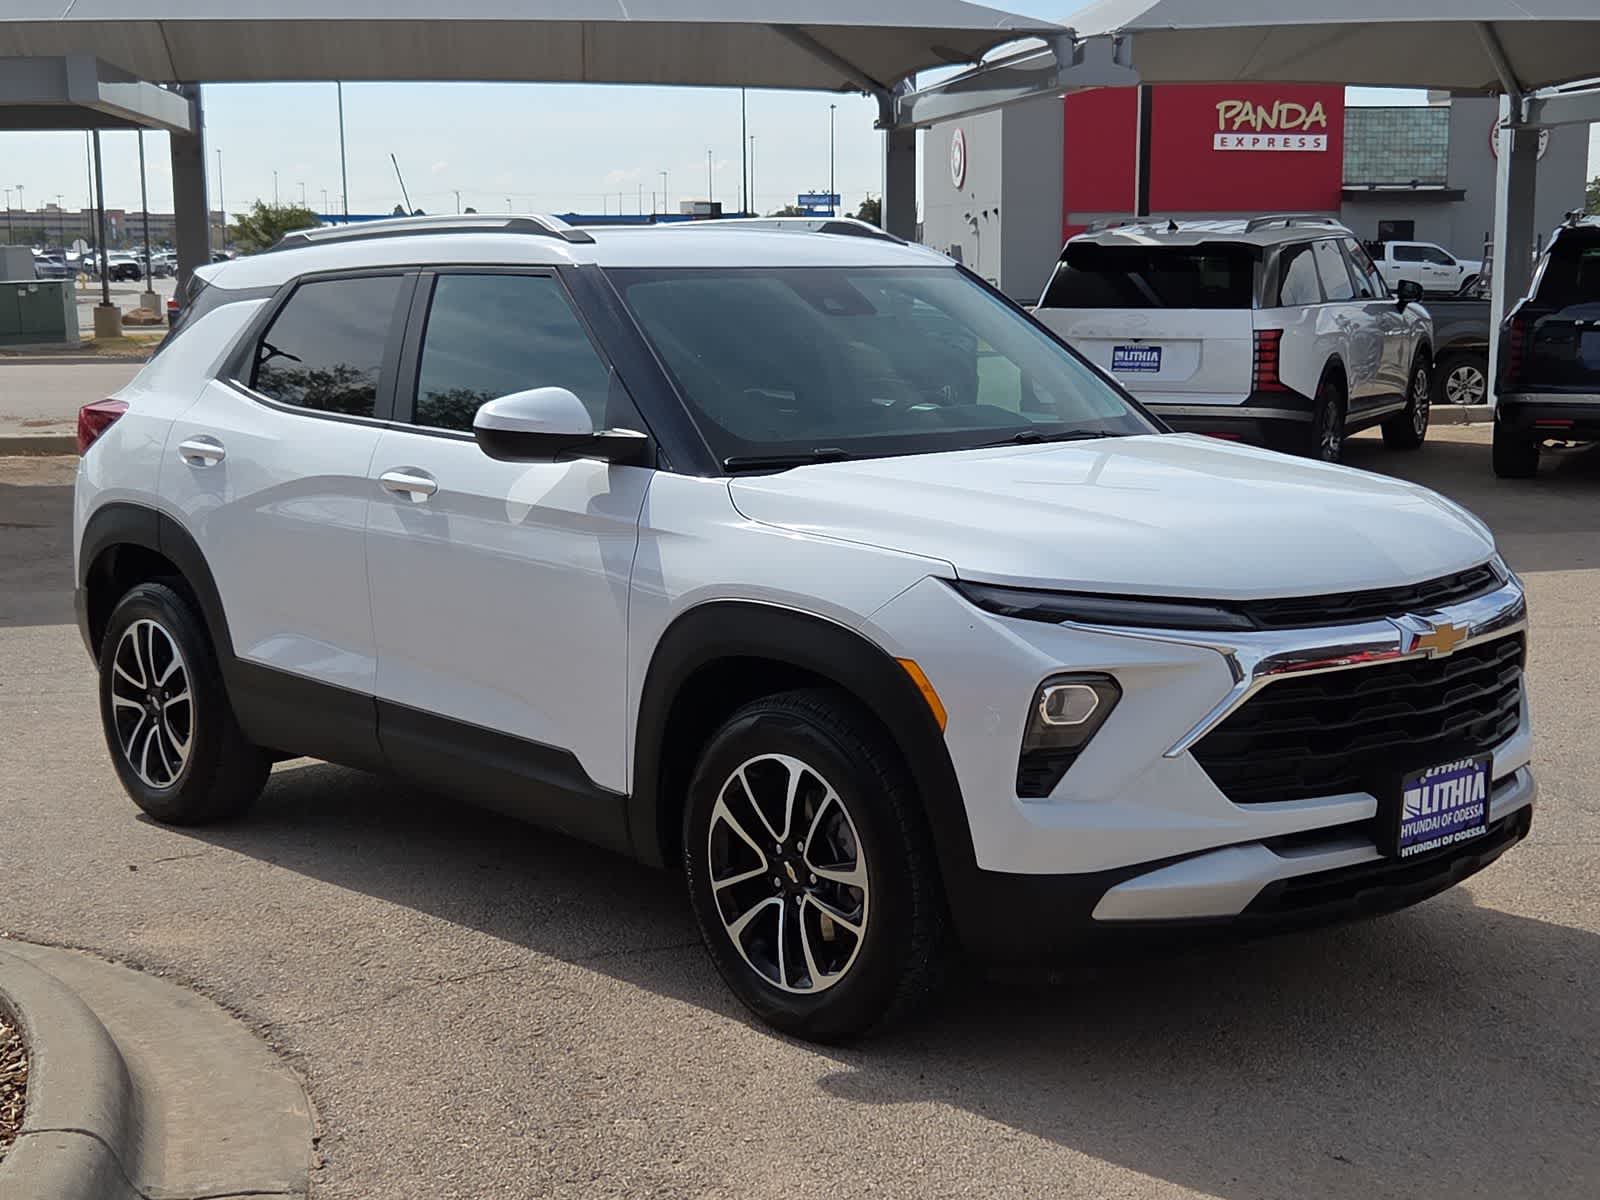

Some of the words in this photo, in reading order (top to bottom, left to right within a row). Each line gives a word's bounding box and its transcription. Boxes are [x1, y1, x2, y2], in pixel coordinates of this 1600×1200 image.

[1216, 100, 1327, 132] PANDA
[1220, 136, 1321, 148] EXPRESS
[1124, 351, 1158, 361] LITHIA
[1421, 772, 1485, 815] LITHIA
[1400, 815, 1441, 838] HYUNDAI
[1441, 812, 1453, 826] OF
[1453, 803, 1484, 823] ODESSA
[1401, 838, 1442, 858] HYUNDAI
[1442, 833, 1454, 846] OF
[1454, 825, 1486, 841] ODESSA
